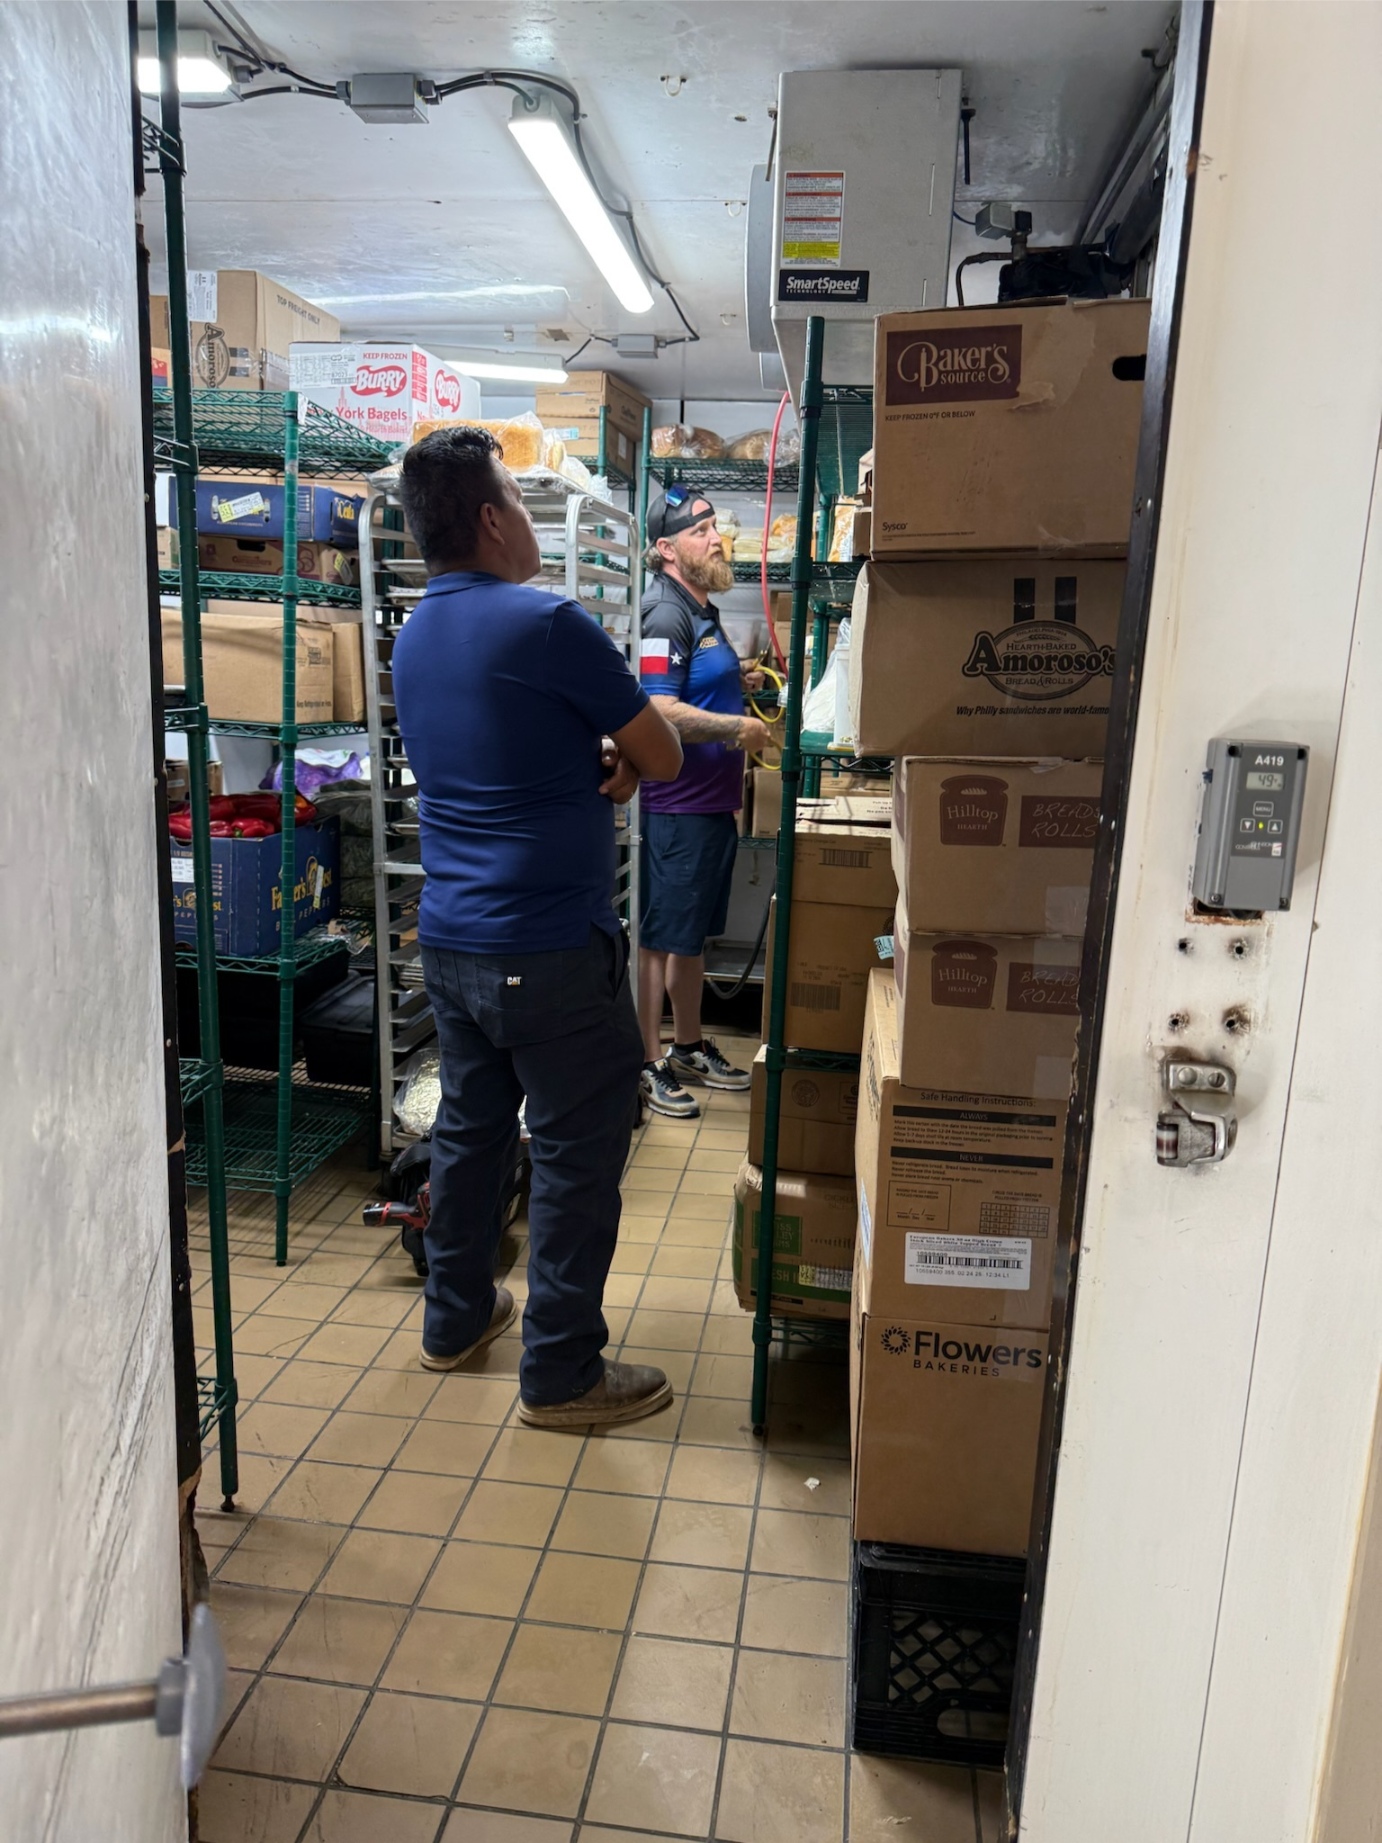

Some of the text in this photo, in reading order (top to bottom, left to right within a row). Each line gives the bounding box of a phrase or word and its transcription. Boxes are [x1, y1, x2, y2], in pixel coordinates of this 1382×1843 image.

[786, 276, 860, 294] SmartSpeed
[363, 352, 408, 360] KEEP FROZEN
[897, 341, 1010, 392] Baker's
[940, 370, 986, 385] source
[336, 406, 365, 419] York
[367, 407, 407, 422] Bagels
[952, 410, 976, 418] BELOW
[882, 522, 907, 533] Sysco
[956, 706, 974, 716] Why
[974, 705, 998, 716] Philly
[999, 706, 1047, 715] sandwiches
[1254, 754, 1285, 766] A419
[946, 804, 999, 823] Hilltop
[957, 823, 988, 831] HEARTH
[1031, 822, 1098, 838] ROLLS
[507, 976, 522, 986] CAT
[939, 968, 988, 987] Hilltop
[920, 1092, 939, 1101] Safe
[941, 1093, 980, 1105] Handling
[960, 1111, 988, 1121] ALWAYS
[959, 1153, 984, 1162] NEVER
[914, 1330, 1042, 1369] Flowers
[913, 1359, 1000, 1377] BAKERIES
